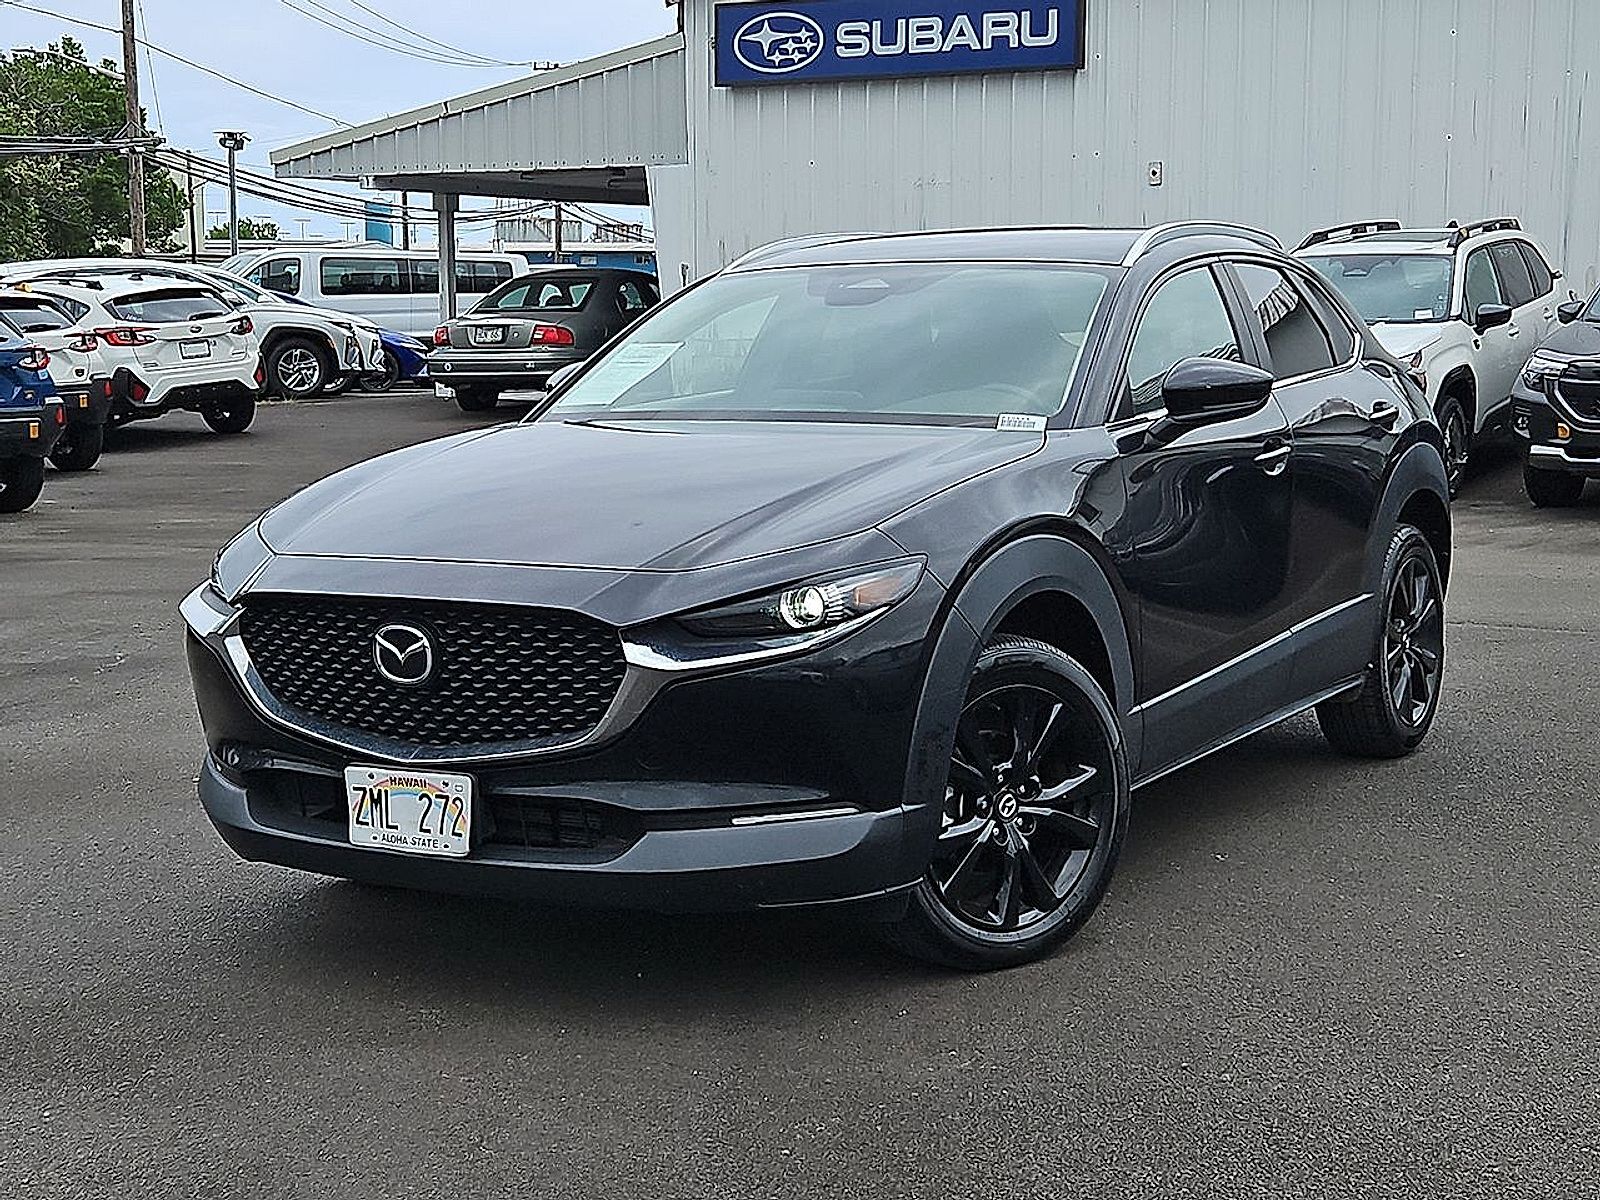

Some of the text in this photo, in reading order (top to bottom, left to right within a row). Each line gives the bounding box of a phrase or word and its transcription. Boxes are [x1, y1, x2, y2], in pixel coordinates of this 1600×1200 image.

[836, 9, 1058, 58] SUBARU
[388, 776, 429, 789] HAWAII
[352, 786, 464, 838] ZML 272
[381, 833, 439, 849] ALOHA STATE
